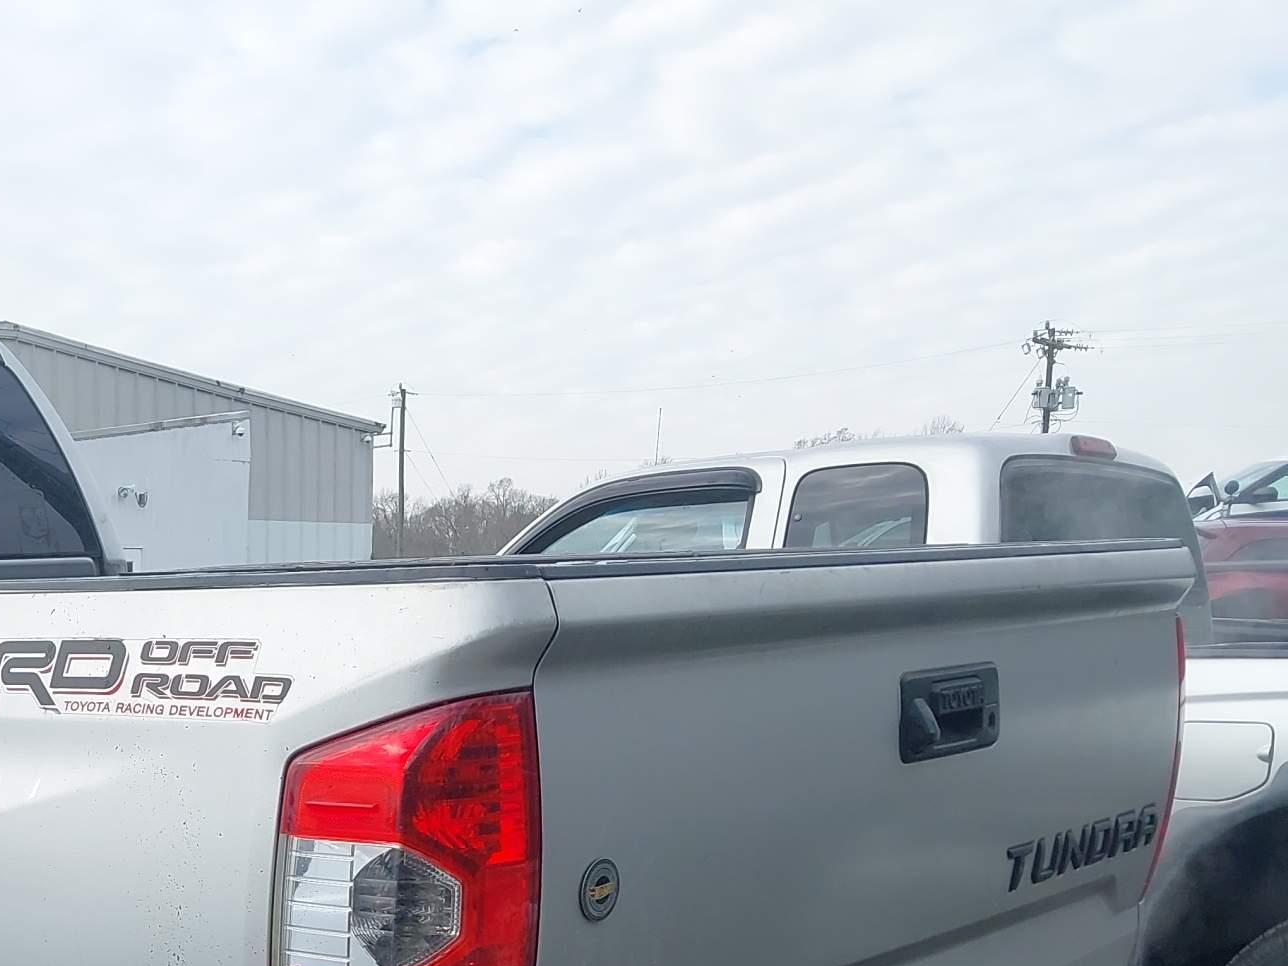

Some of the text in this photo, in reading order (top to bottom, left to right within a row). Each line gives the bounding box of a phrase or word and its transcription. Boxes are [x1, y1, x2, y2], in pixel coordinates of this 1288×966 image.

[139, 640, 260, 666] OFF
[130, 672, 295, 704] ROAD
[64, 700, 274, 721] TOYOTA RACING DEVELOPMENT
[1006, 803, 1159, 893] TUNDRA
